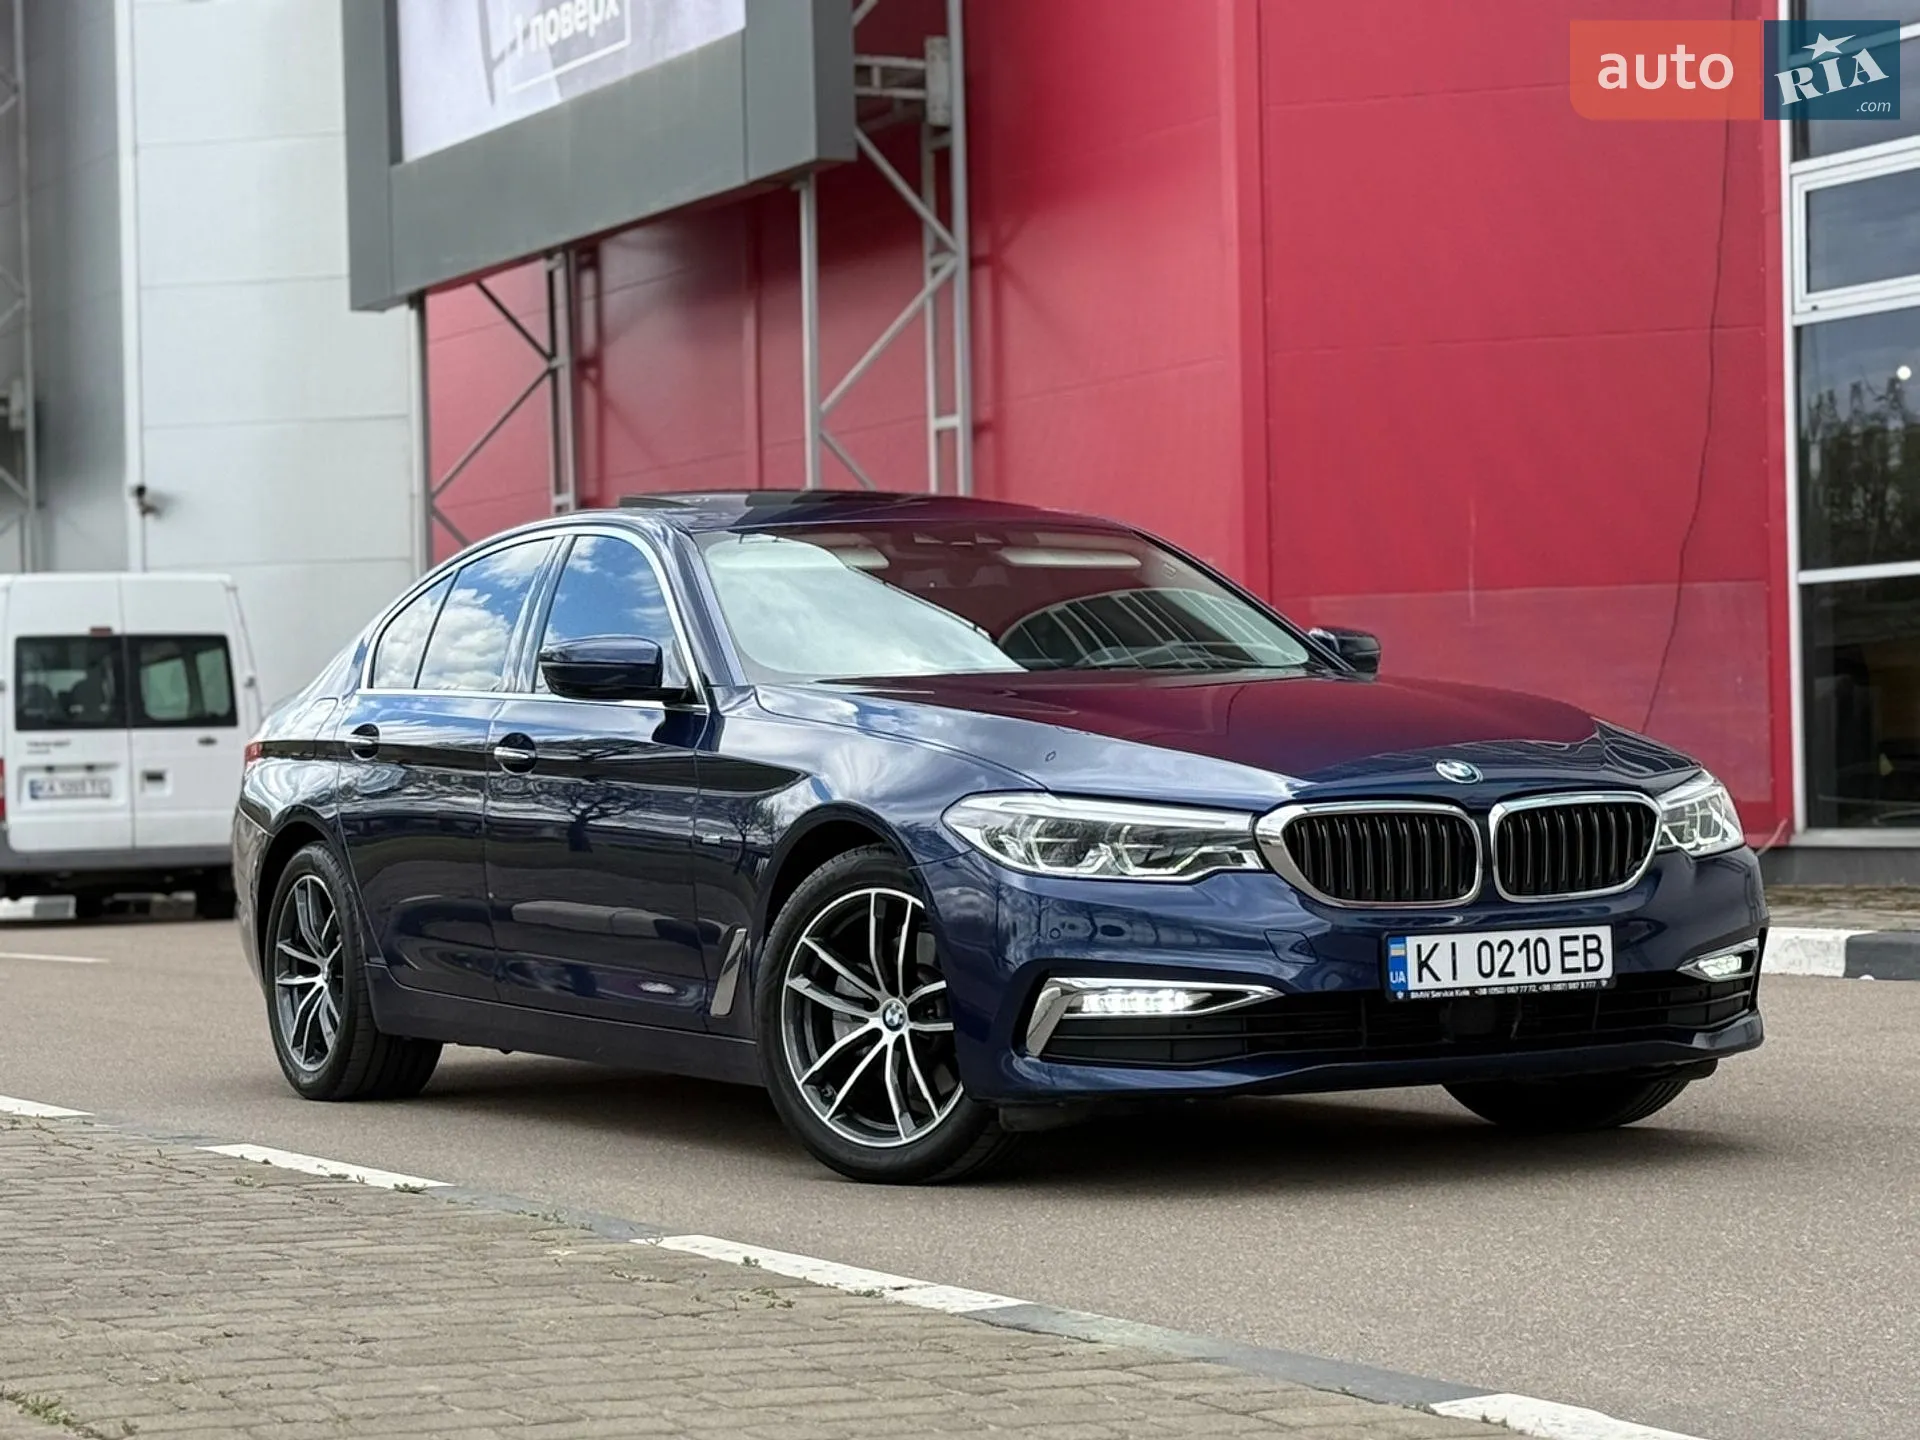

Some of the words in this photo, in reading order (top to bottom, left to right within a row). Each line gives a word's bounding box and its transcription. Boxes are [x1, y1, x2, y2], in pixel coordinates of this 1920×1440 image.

[529, 0, 620, 51] поверх
[1390, 970, 1406, 984] UA
[1416, 941, 1458, 983] KI
[1477, 936, 1551, 979] 0210
[1559, 934, 1604, 975] EB
